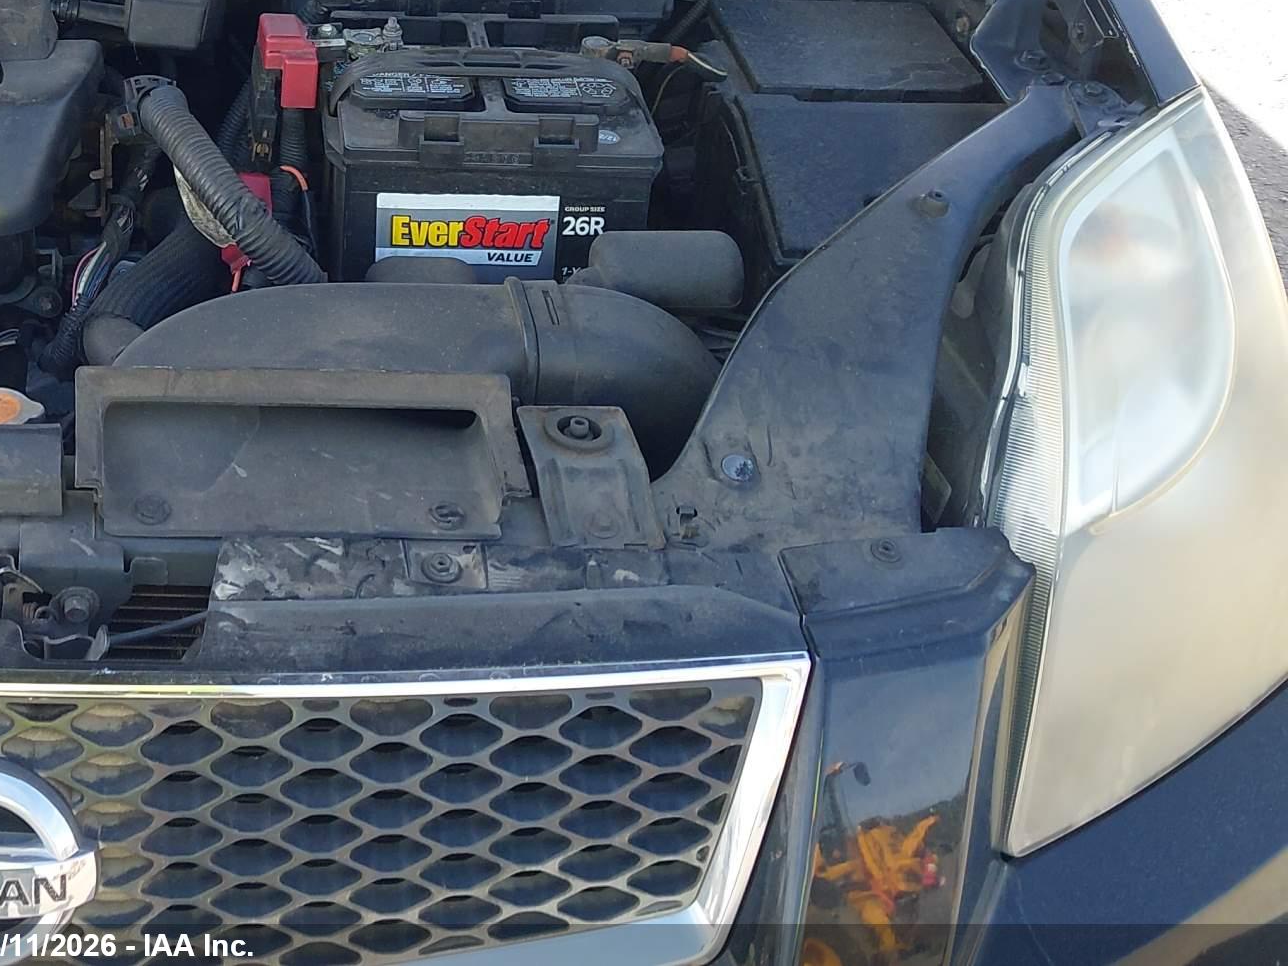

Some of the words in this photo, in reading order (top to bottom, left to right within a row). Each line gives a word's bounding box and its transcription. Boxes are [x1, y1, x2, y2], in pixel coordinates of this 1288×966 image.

[392, 215, 551, 249] EverStart
[562, 216, 605, 236] 26R
[487, 252, 534, 263] VALUE
